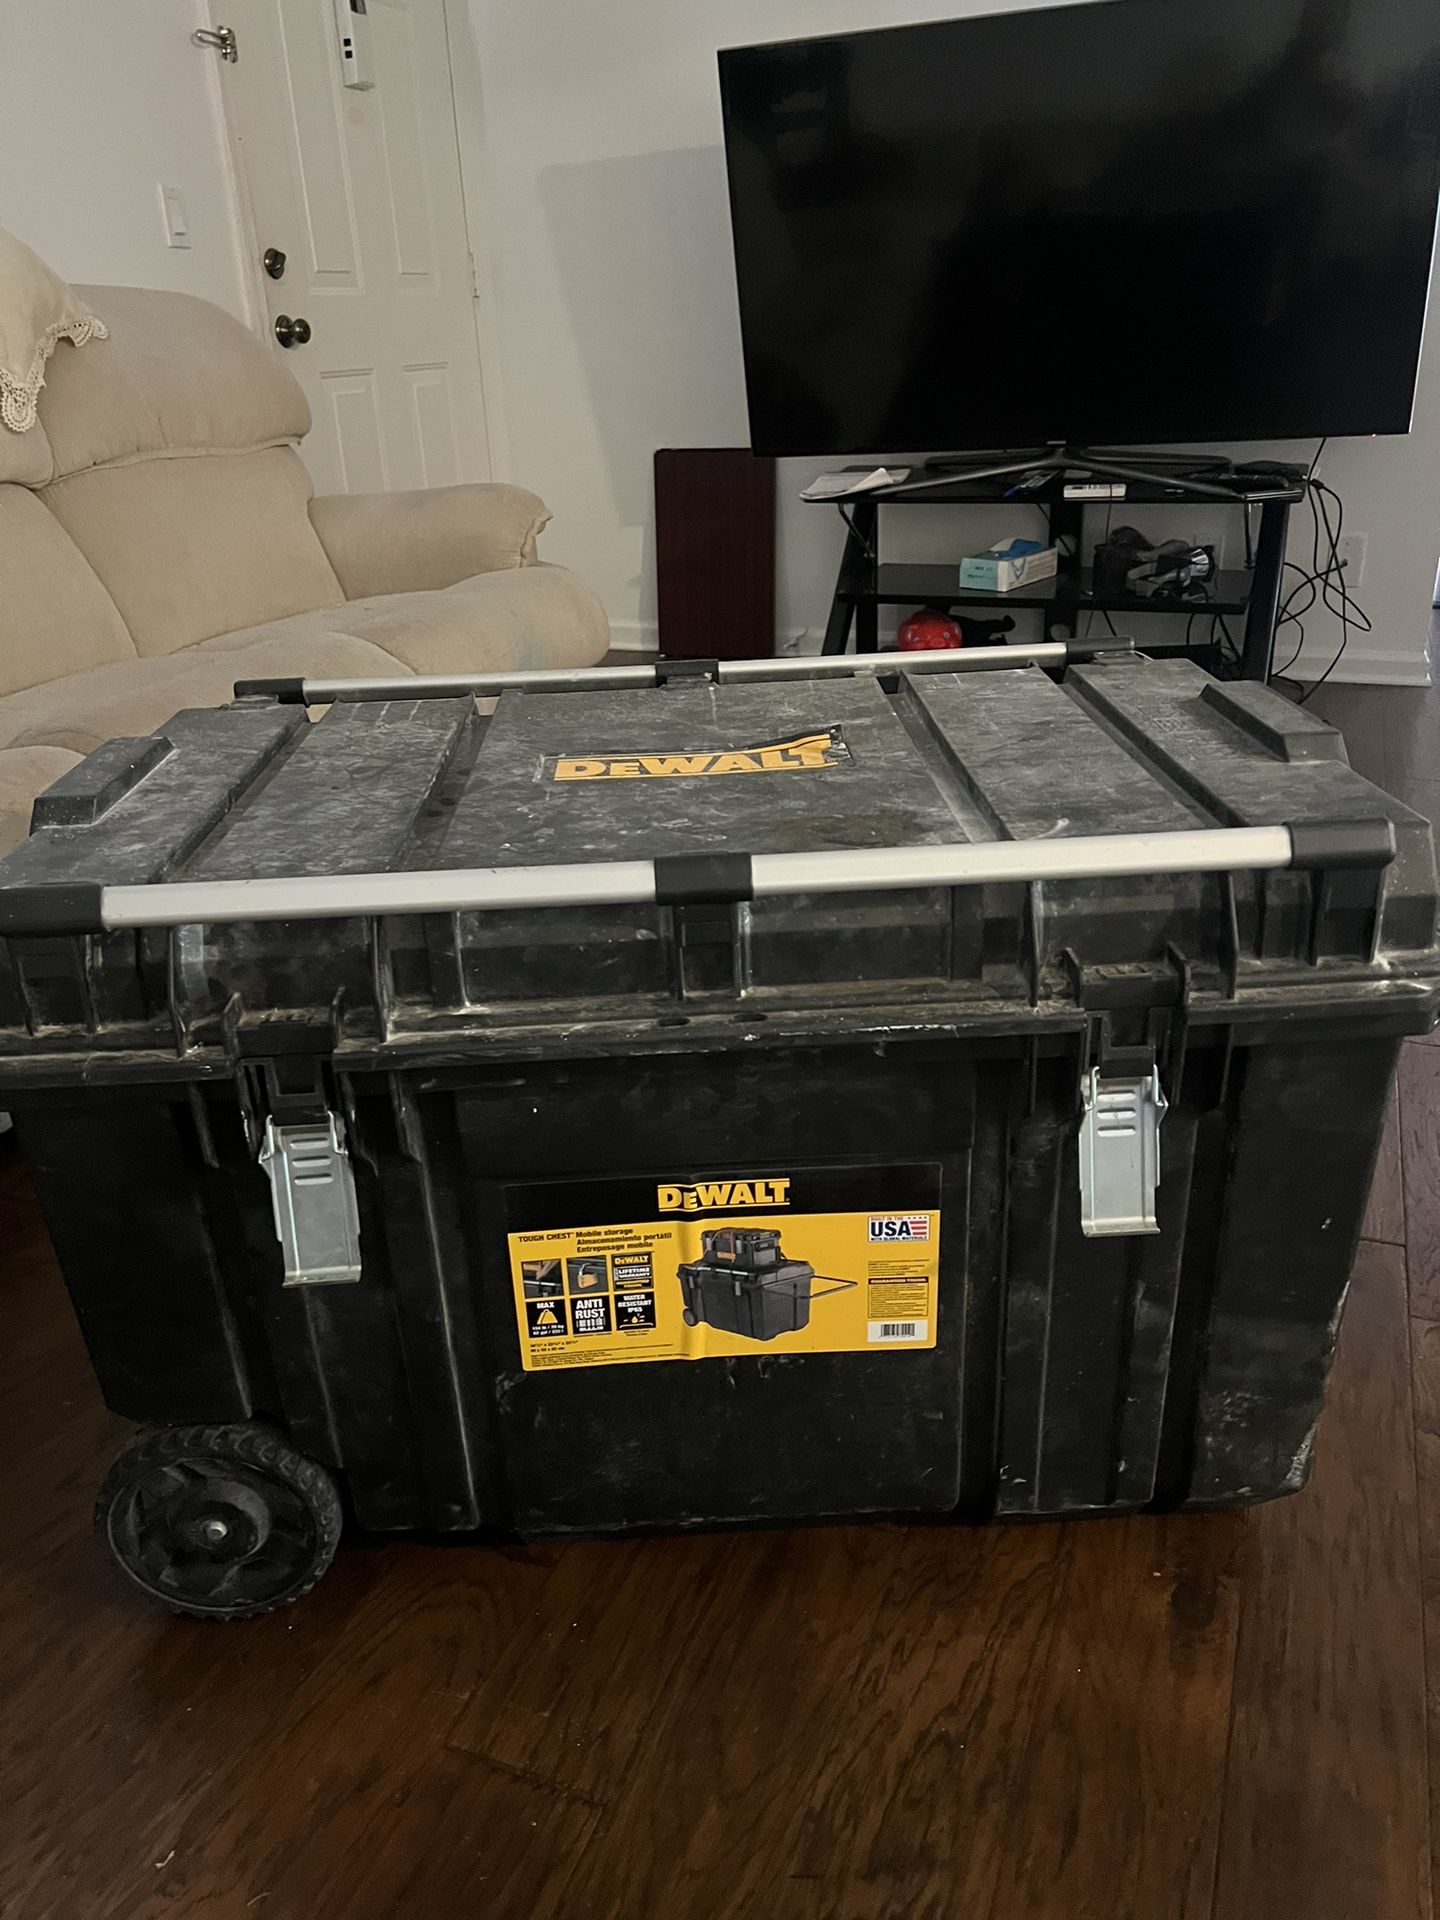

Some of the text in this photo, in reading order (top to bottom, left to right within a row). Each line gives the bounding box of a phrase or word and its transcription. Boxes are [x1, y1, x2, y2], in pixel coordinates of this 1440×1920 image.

[554, 738, 832, 778] DEWALT
[657, 1181, 790, 1210] DEWALT
[575, 1228, 634, 1238] Mobile storage
[870, 1220, 911, 1237] USA
[518, 1234, 545, 1243] TOUGH
[576, 1232, 672, 1245] Almacenamiento portátil
[576, 1241, 654, 1253] Entreposage mobile
[618, 1267, 650, 1275] LIFETIME
[536, 1301, 555, 1309] MAX
[576, 1298, 603, 1310] ANTI
[617, 1299, 652, 1308] RESISTANT
[575, 1308, 605, 1320] RUST
